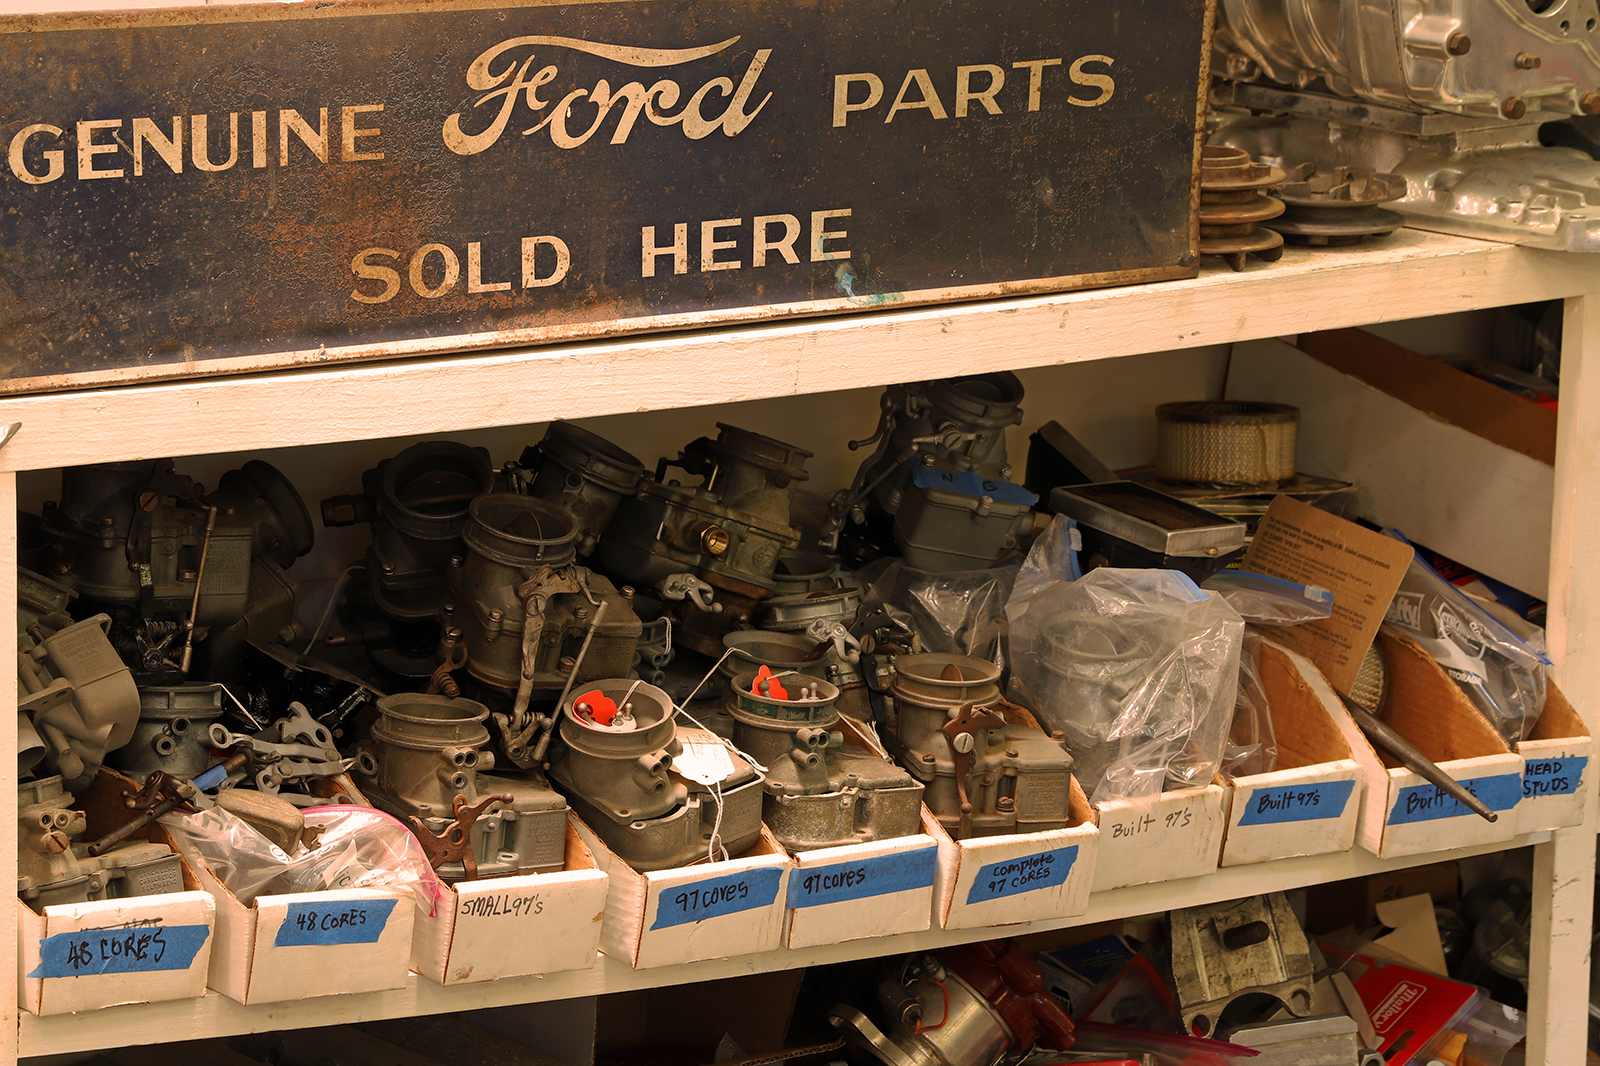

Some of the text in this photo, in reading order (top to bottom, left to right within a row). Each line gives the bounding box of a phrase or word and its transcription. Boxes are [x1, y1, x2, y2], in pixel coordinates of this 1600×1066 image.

[8, 34, 1115, 185] GENUINE Ford PARTS
[350, 208, 852, 304] SOLD HERE
[1526, 761, 1562, 776] HEAD
[1523, 777, 1569, 795] STUDS
[1257, 789, 1321, 814] Built 97's
[1112, 807, 1192, 838] Built 97's
[988, 878, 1007, 893] 97
[297, 909, 367, 931] 48 CORES
[66, 928, 166, 970] 48 CORES
[1373, 988, 1418, 1029] Mallory
